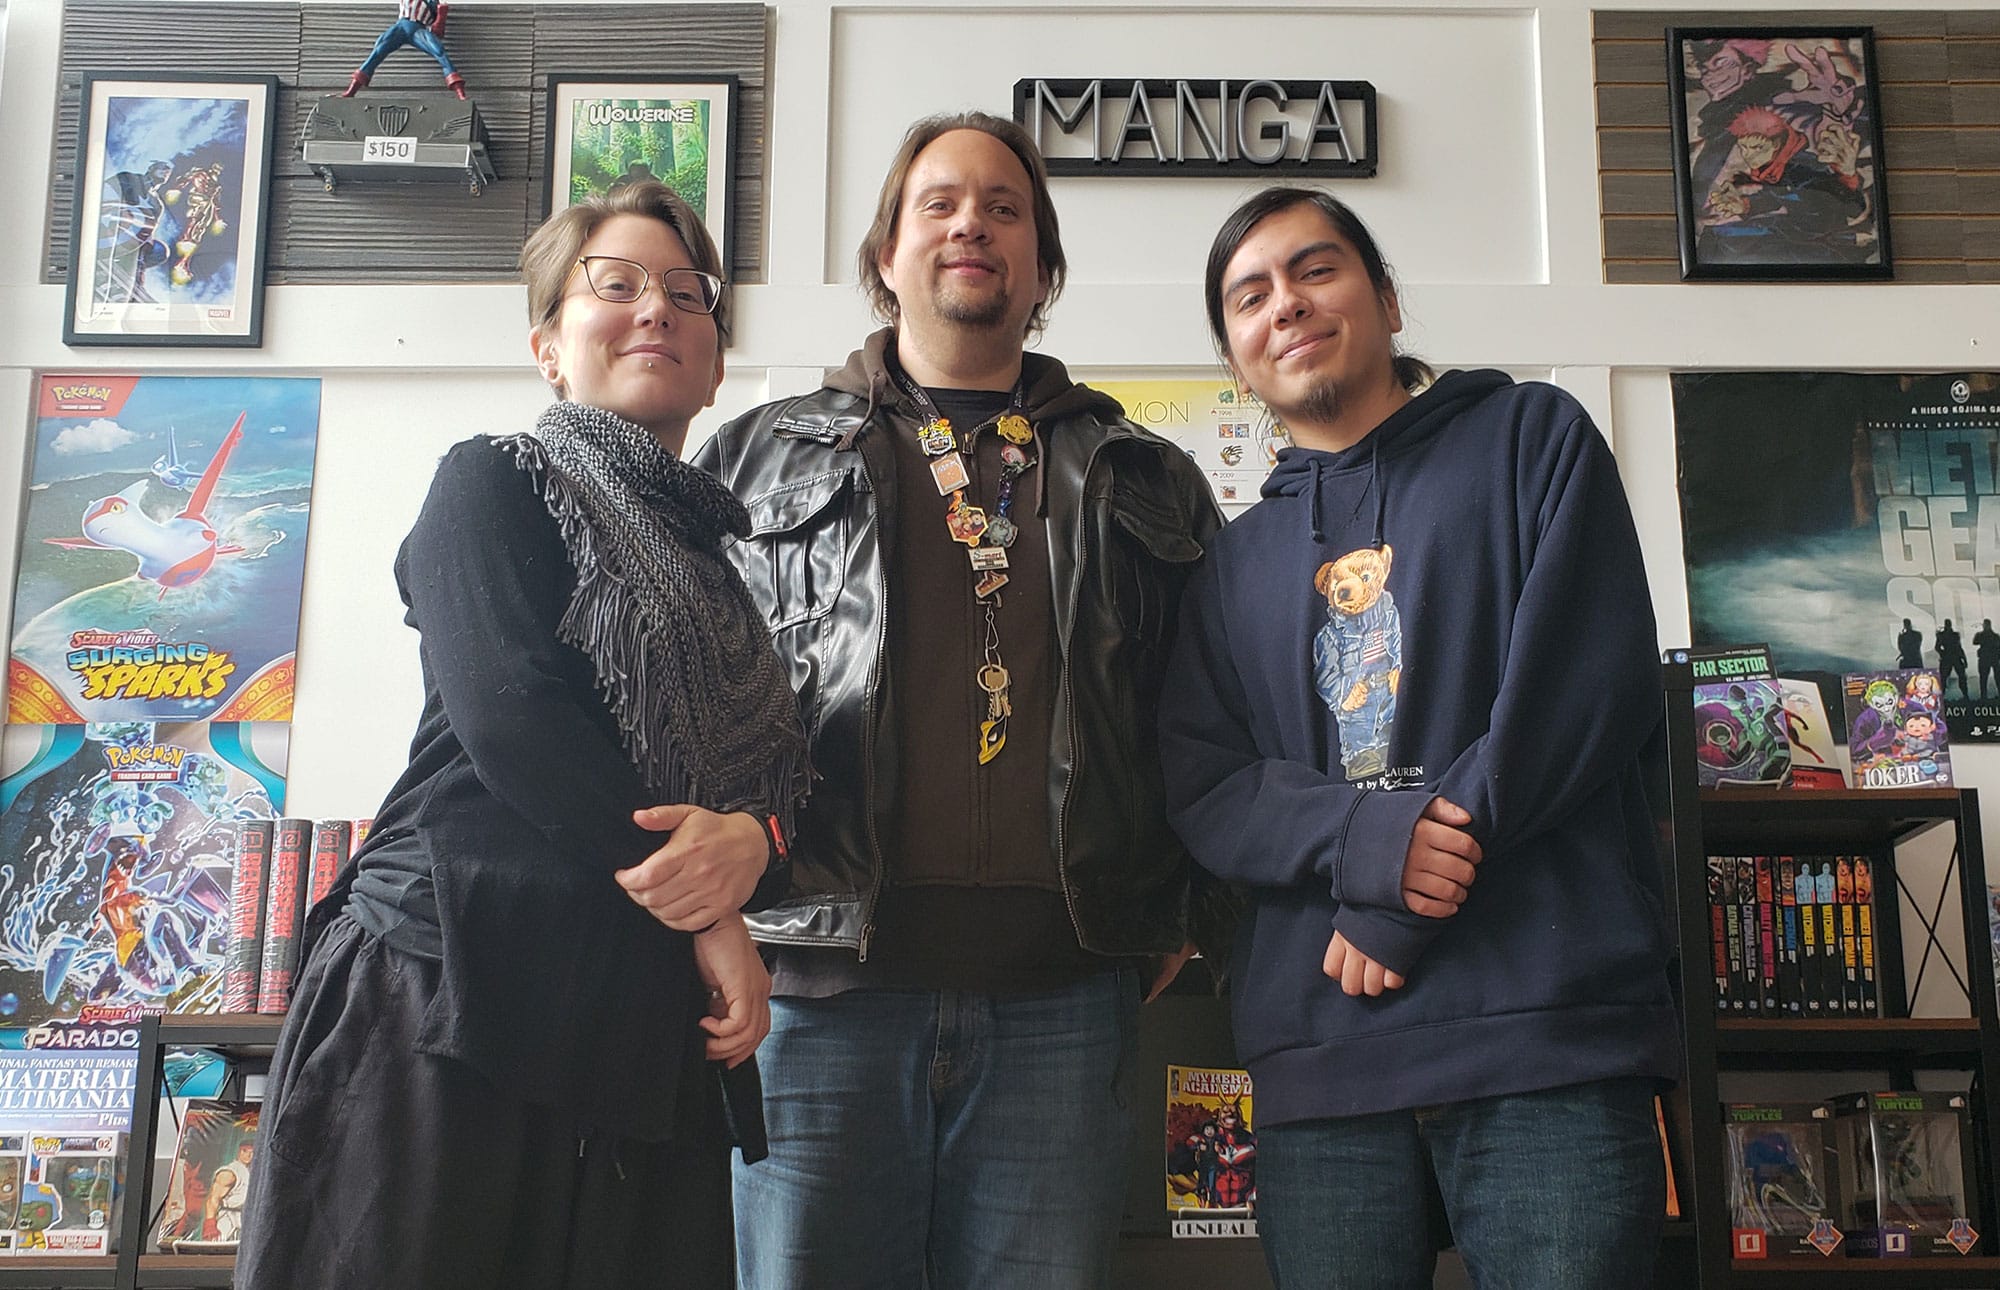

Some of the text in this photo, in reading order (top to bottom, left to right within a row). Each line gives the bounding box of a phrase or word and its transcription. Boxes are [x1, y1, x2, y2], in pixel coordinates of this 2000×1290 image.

[589, 104, 695, 126] WOLVERINE
[1034, 79, 1357, 165] MANGA
[368, 141, 409, 158] $150
[1911, 406, 1918, 415] A
[1920, 406, 1949, 415] HIDEO
[1952, 405, 1987, 414] KOJIMA
[67, 642, 209, 670] SURGING
[81, 652, 237, 700] SPARKS
[1692, 655, 1769, 678] FAR SECTOR
[1946, 706, 1967, 717] ACY
[1384, 766, 1424, 778] LAUREN
[1863, 765, 1920, 787] JOKER
[25, 1027, 141, 1049] PARADO
[30, 1058, 79, 1069] FANTASY
[0, 1069, 137, 1090] MATERIAL
[1187, 1071, 1251, 1085] MY HERO
[98, 1113, 129, 1126] Plus
[1175, 1222, 1246, 1236] GENERAL
